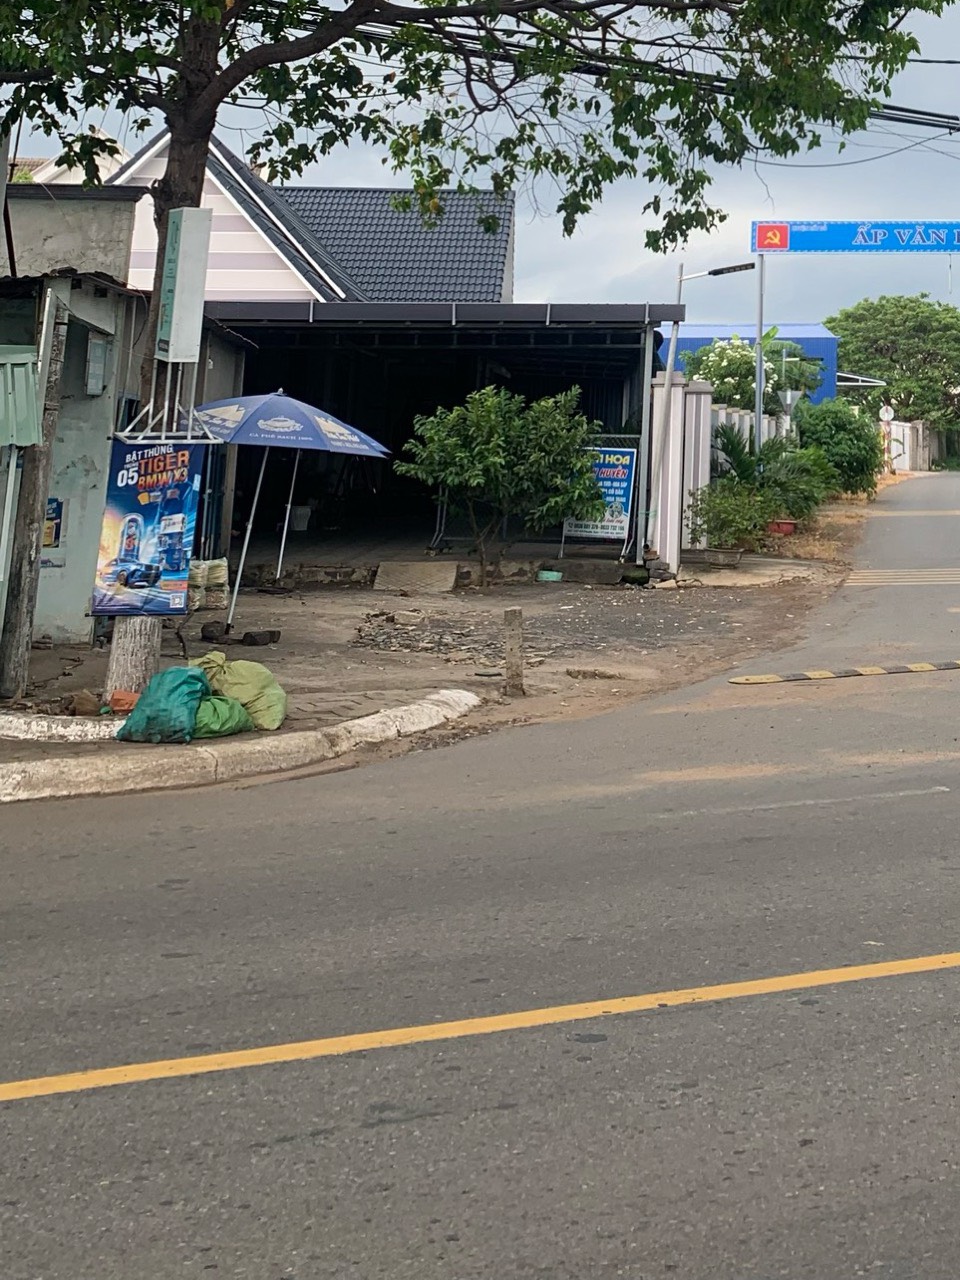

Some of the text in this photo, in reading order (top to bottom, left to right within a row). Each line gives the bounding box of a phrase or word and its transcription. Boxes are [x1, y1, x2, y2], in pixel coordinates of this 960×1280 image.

[852, 223, 888, 245] ẤP
[894, 225, 948, 245] VĂN
[125, 444, 174, 463] BẬT THÙNG
[138, 450, 190, 474] TIGER
[117, 467, 138, 487] 05
[137, 467, 188, 491] BMW X3
